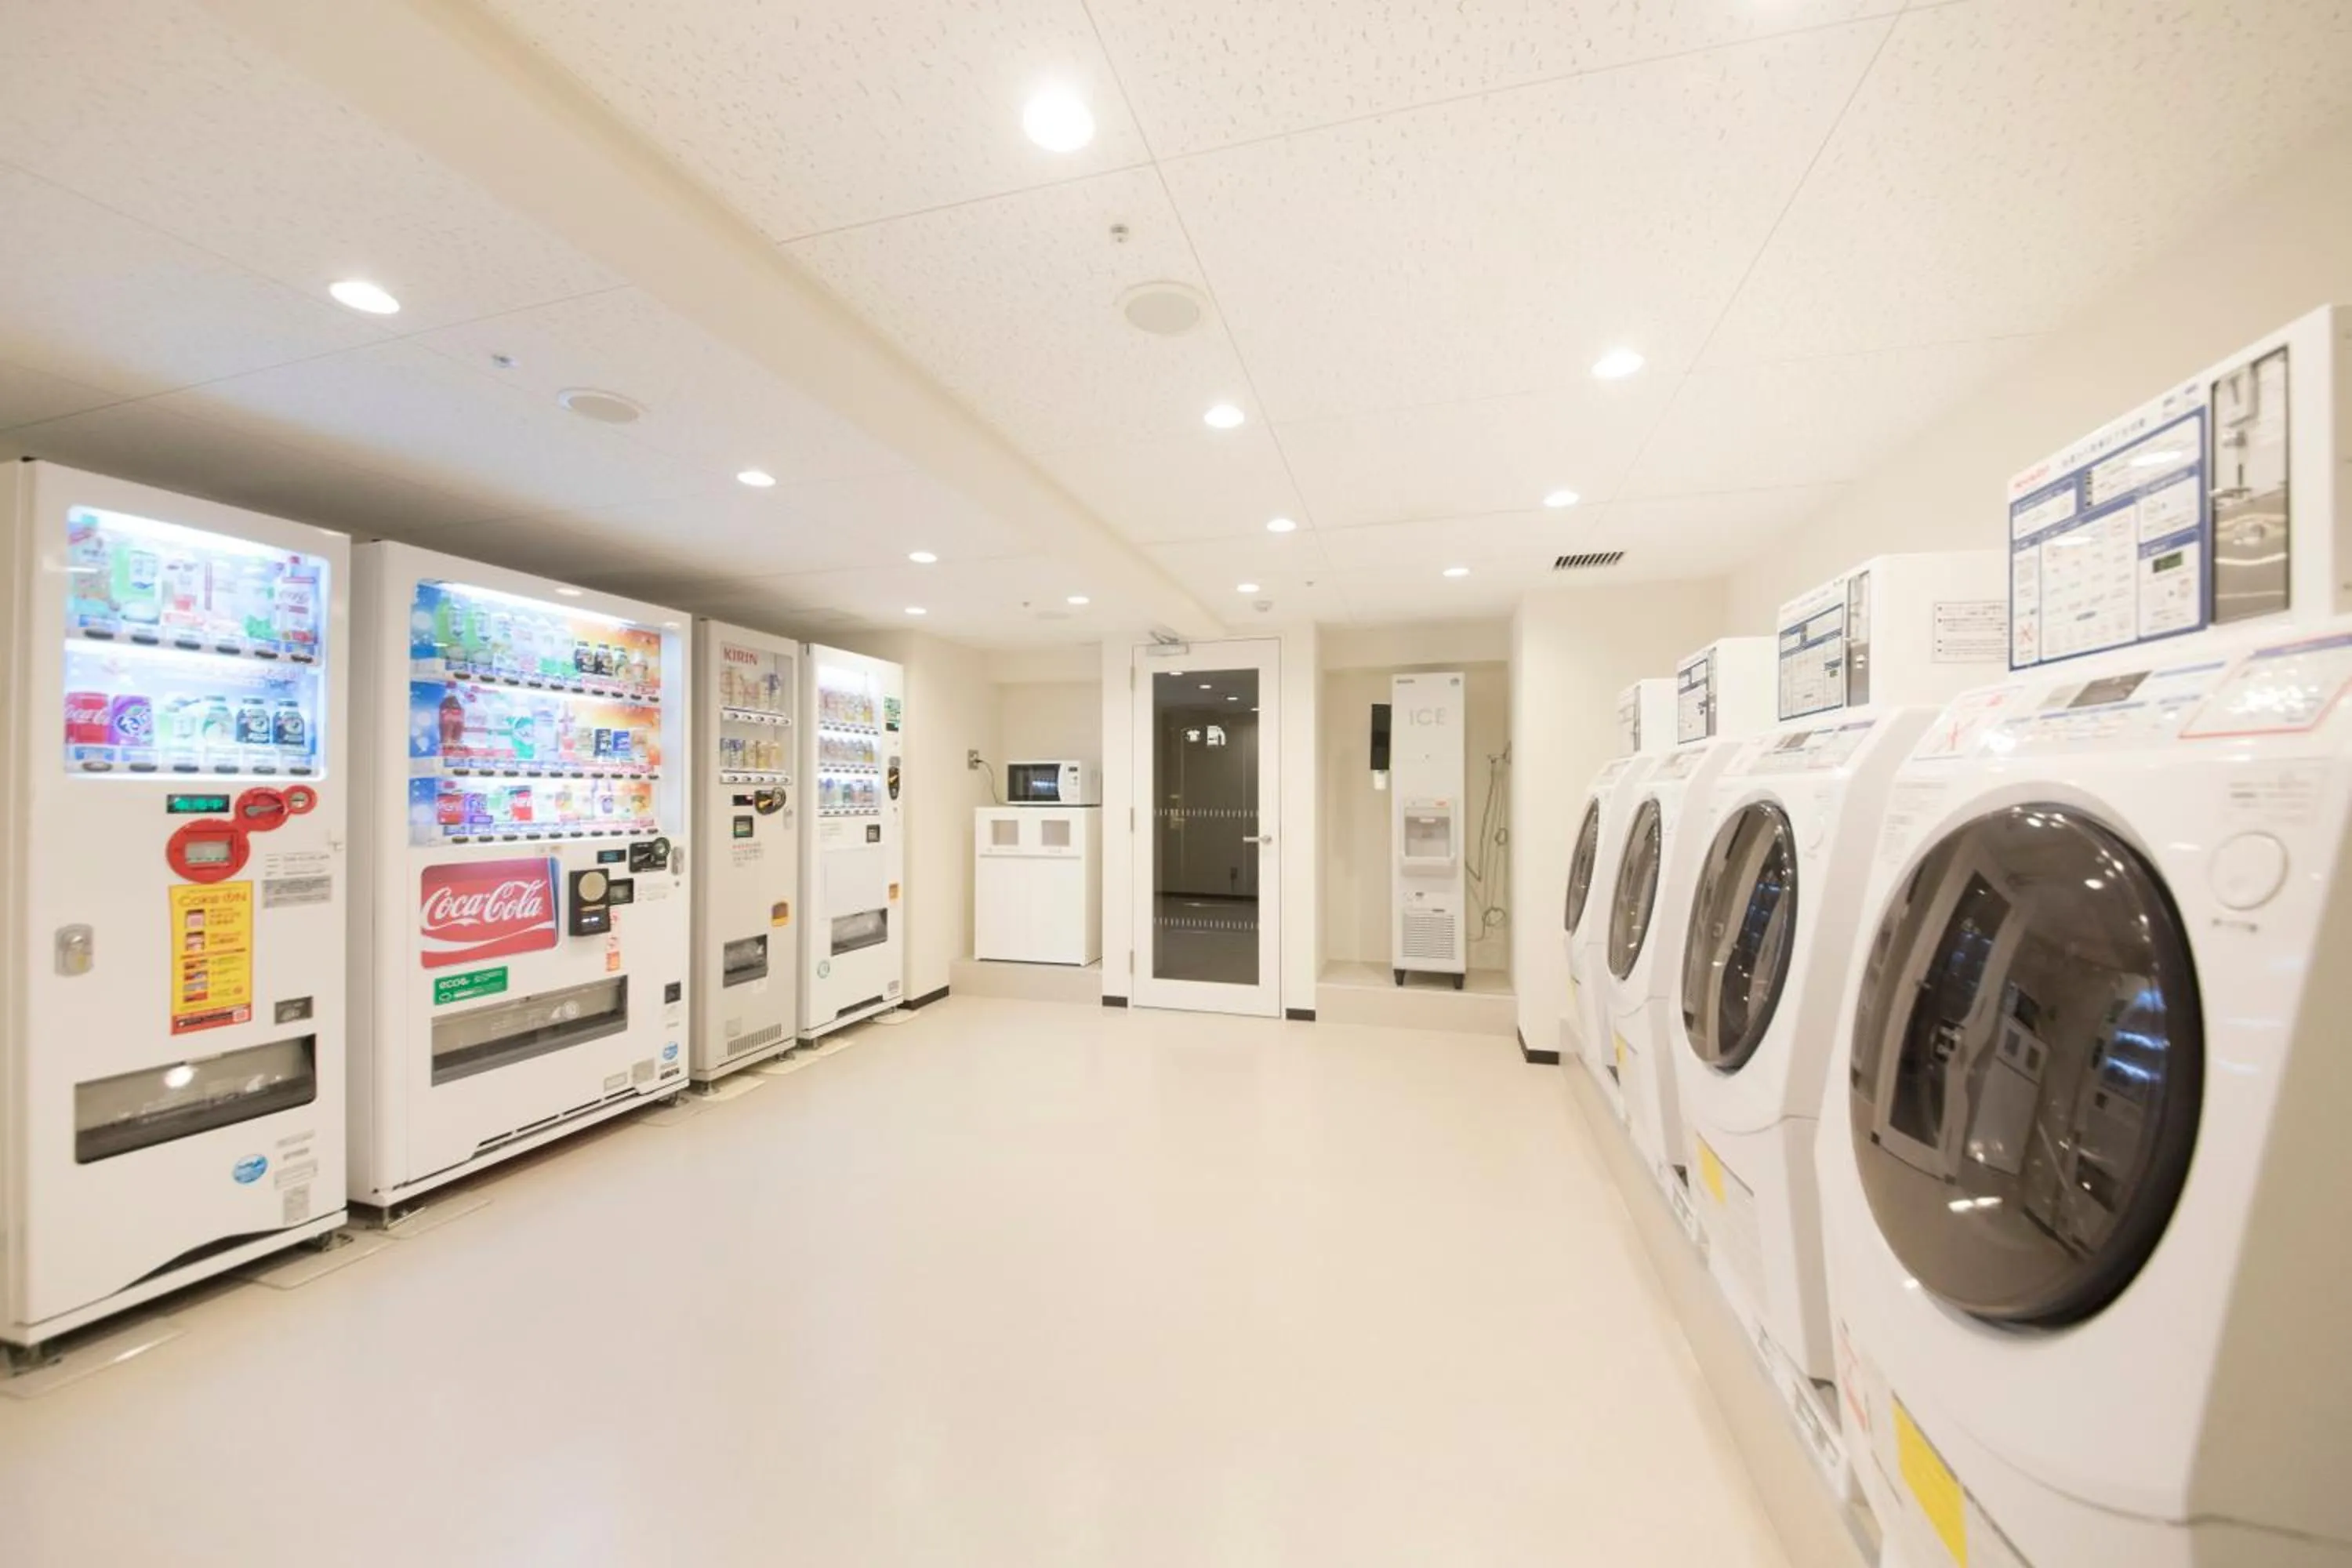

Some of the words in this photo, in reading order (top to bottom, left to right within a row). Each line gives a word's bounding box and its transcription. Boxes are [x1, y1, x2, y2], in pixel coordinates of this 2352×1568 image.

[723, 646, 758, 666] KIRIN
[1409, 707, 1446, 726] ICE
[420, 879, 547, 931] Coca-Cola
